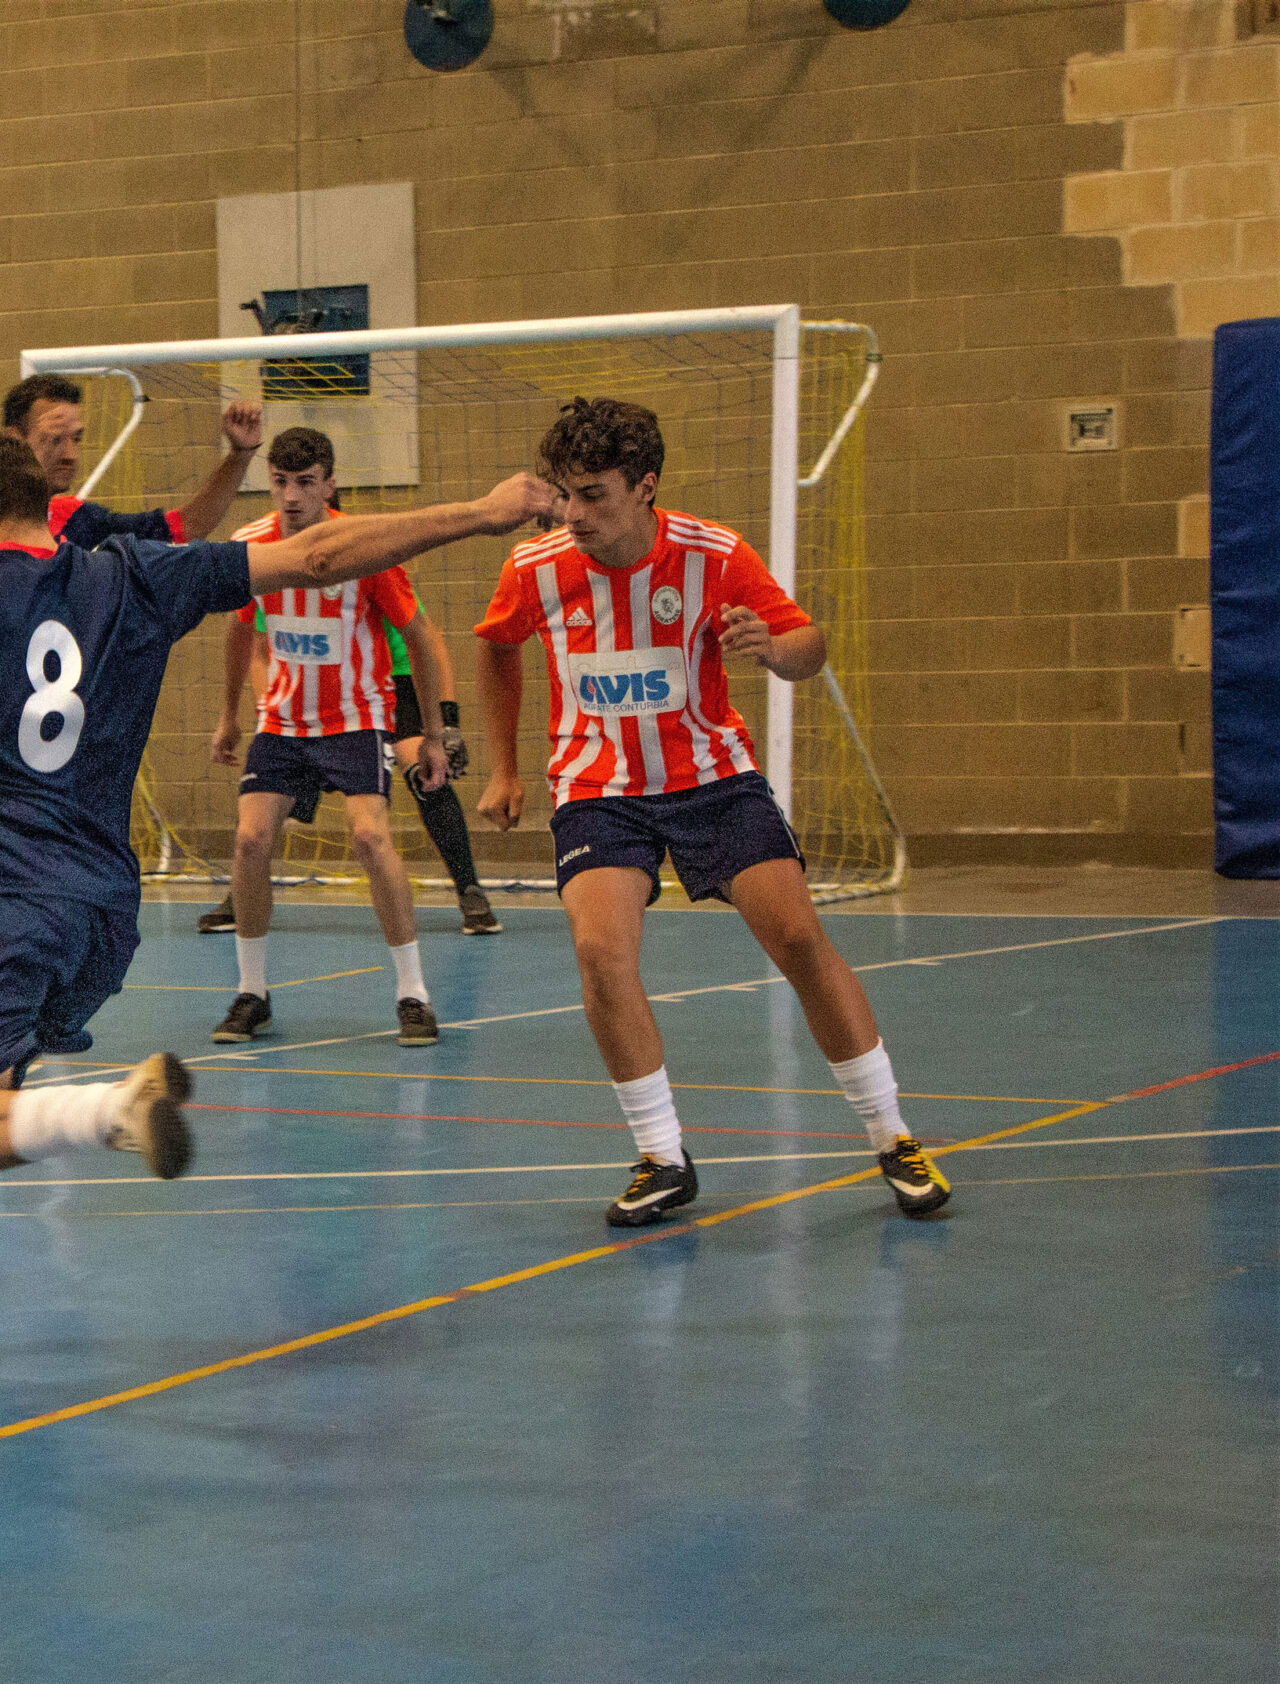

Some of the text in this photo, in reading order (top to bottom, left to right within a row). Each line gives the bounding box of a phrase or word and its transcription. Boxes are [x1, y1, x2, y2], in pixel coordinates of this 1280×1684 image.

[275, 631, 330, 656] AVIS
[18, 619, 85, 773] 8
[579, 669, 670, 704] AVIS
